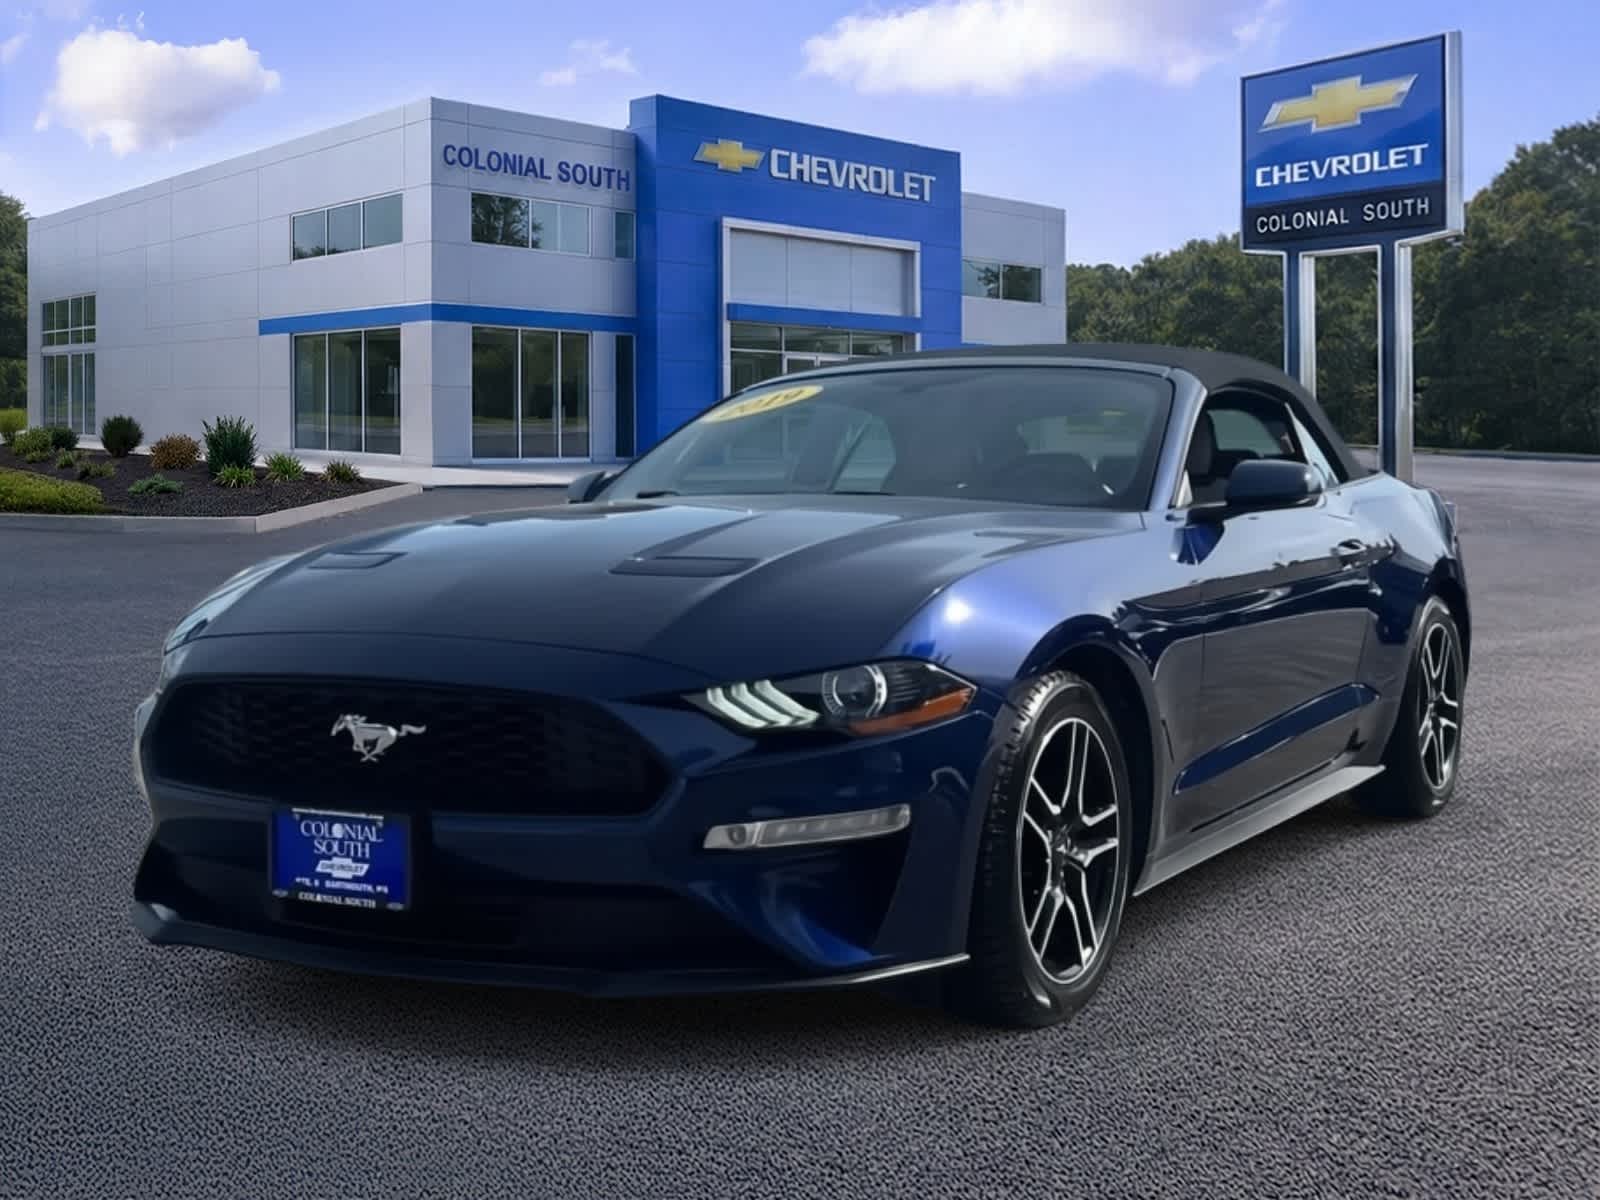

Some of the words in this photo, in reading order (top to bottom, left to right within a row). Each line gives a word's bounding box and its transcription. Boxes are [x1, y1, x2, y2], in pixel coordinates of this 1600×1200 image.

[443, 144, 552, 180] COLONIAL
[557, 160, 631, 191] SOUTH
[770, 148, 937, 202] CHEVROLET
[1255, 143, 1429, 187] CHEVROLET
[1256, 207, 1349, 233] COLONIAL
[1362, 197, 1429, 222] SOUTH
[300, 819, 384, 842] COLONIAL
[313, 839, 370, 858] SOUTH
